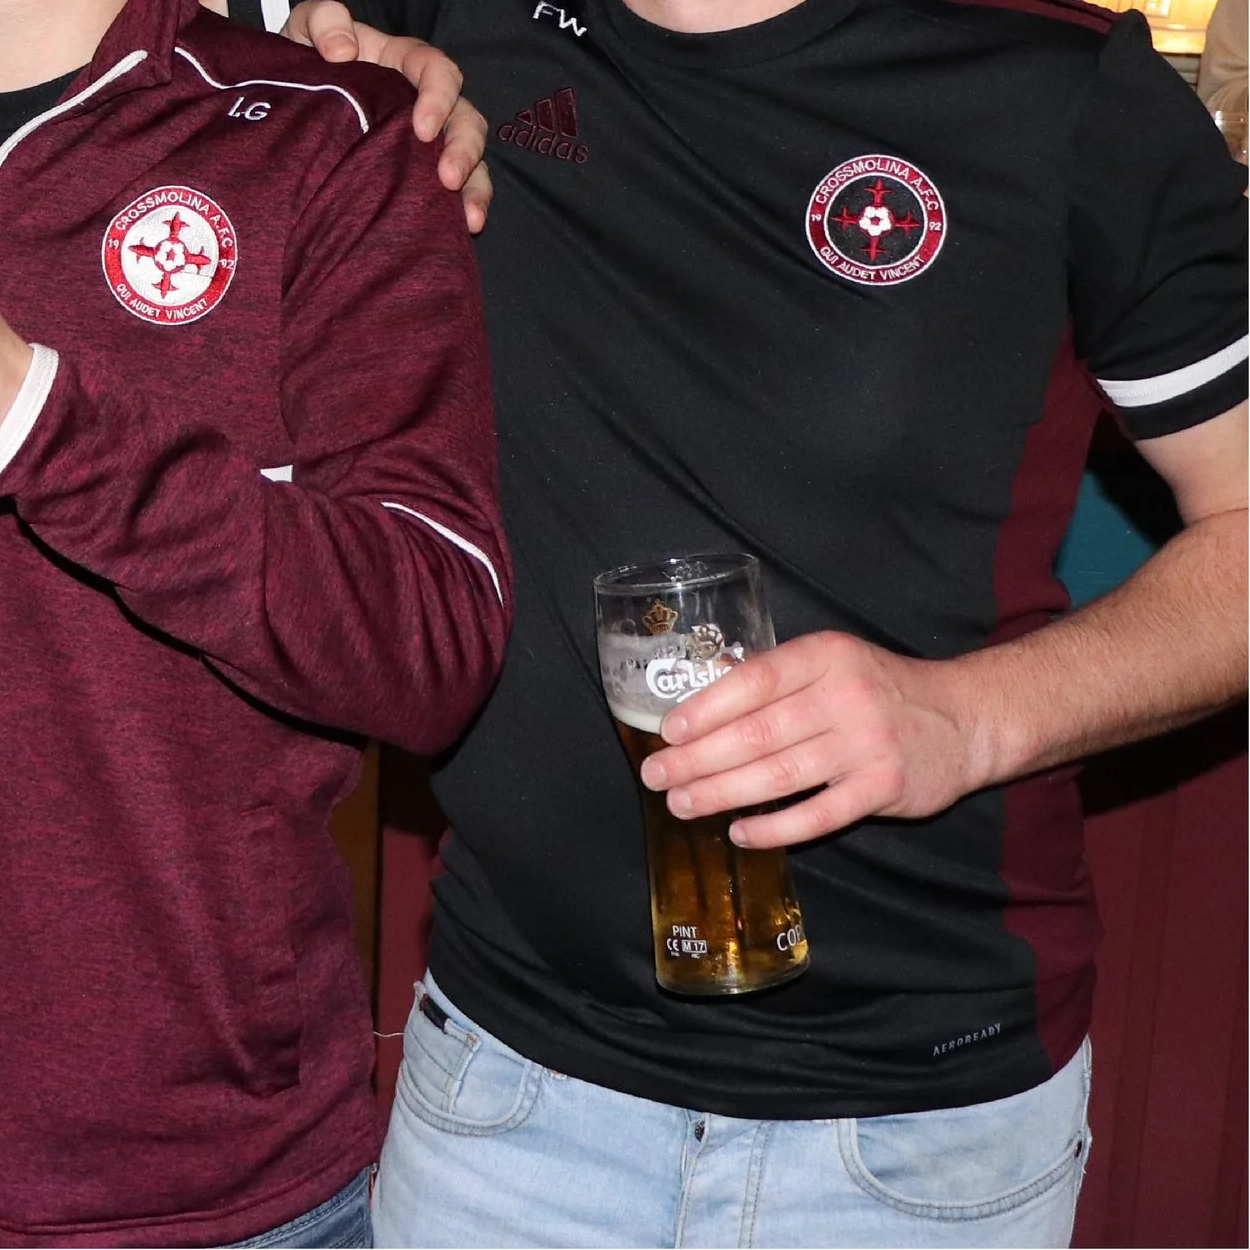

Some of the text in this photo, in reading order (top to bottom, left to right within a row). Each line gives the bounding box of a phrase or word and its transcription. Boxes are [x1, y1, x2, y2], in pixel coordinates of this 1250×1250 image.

[532, 0, 588, 37] FW
[498, 123, 589, 165] adidas
[815, 158, 910, 204] CROSSMOLINA
[115, 191, 210, 231] CROSSMOLINA
[929, 221, 941, 231] 92
[108, 237, 120, 250] 19
[221, 258, 235, 270] 92
[820, 246, 925, 280] QUI AUDET VINCENT
[116, 283, 208, 320] QUI AUDET VINCENT
[646, 657, 733, 700] Carlsb
[672, 924, 697, 939] PINT
[932, 1022, 1002, 1057] AEROREADY
